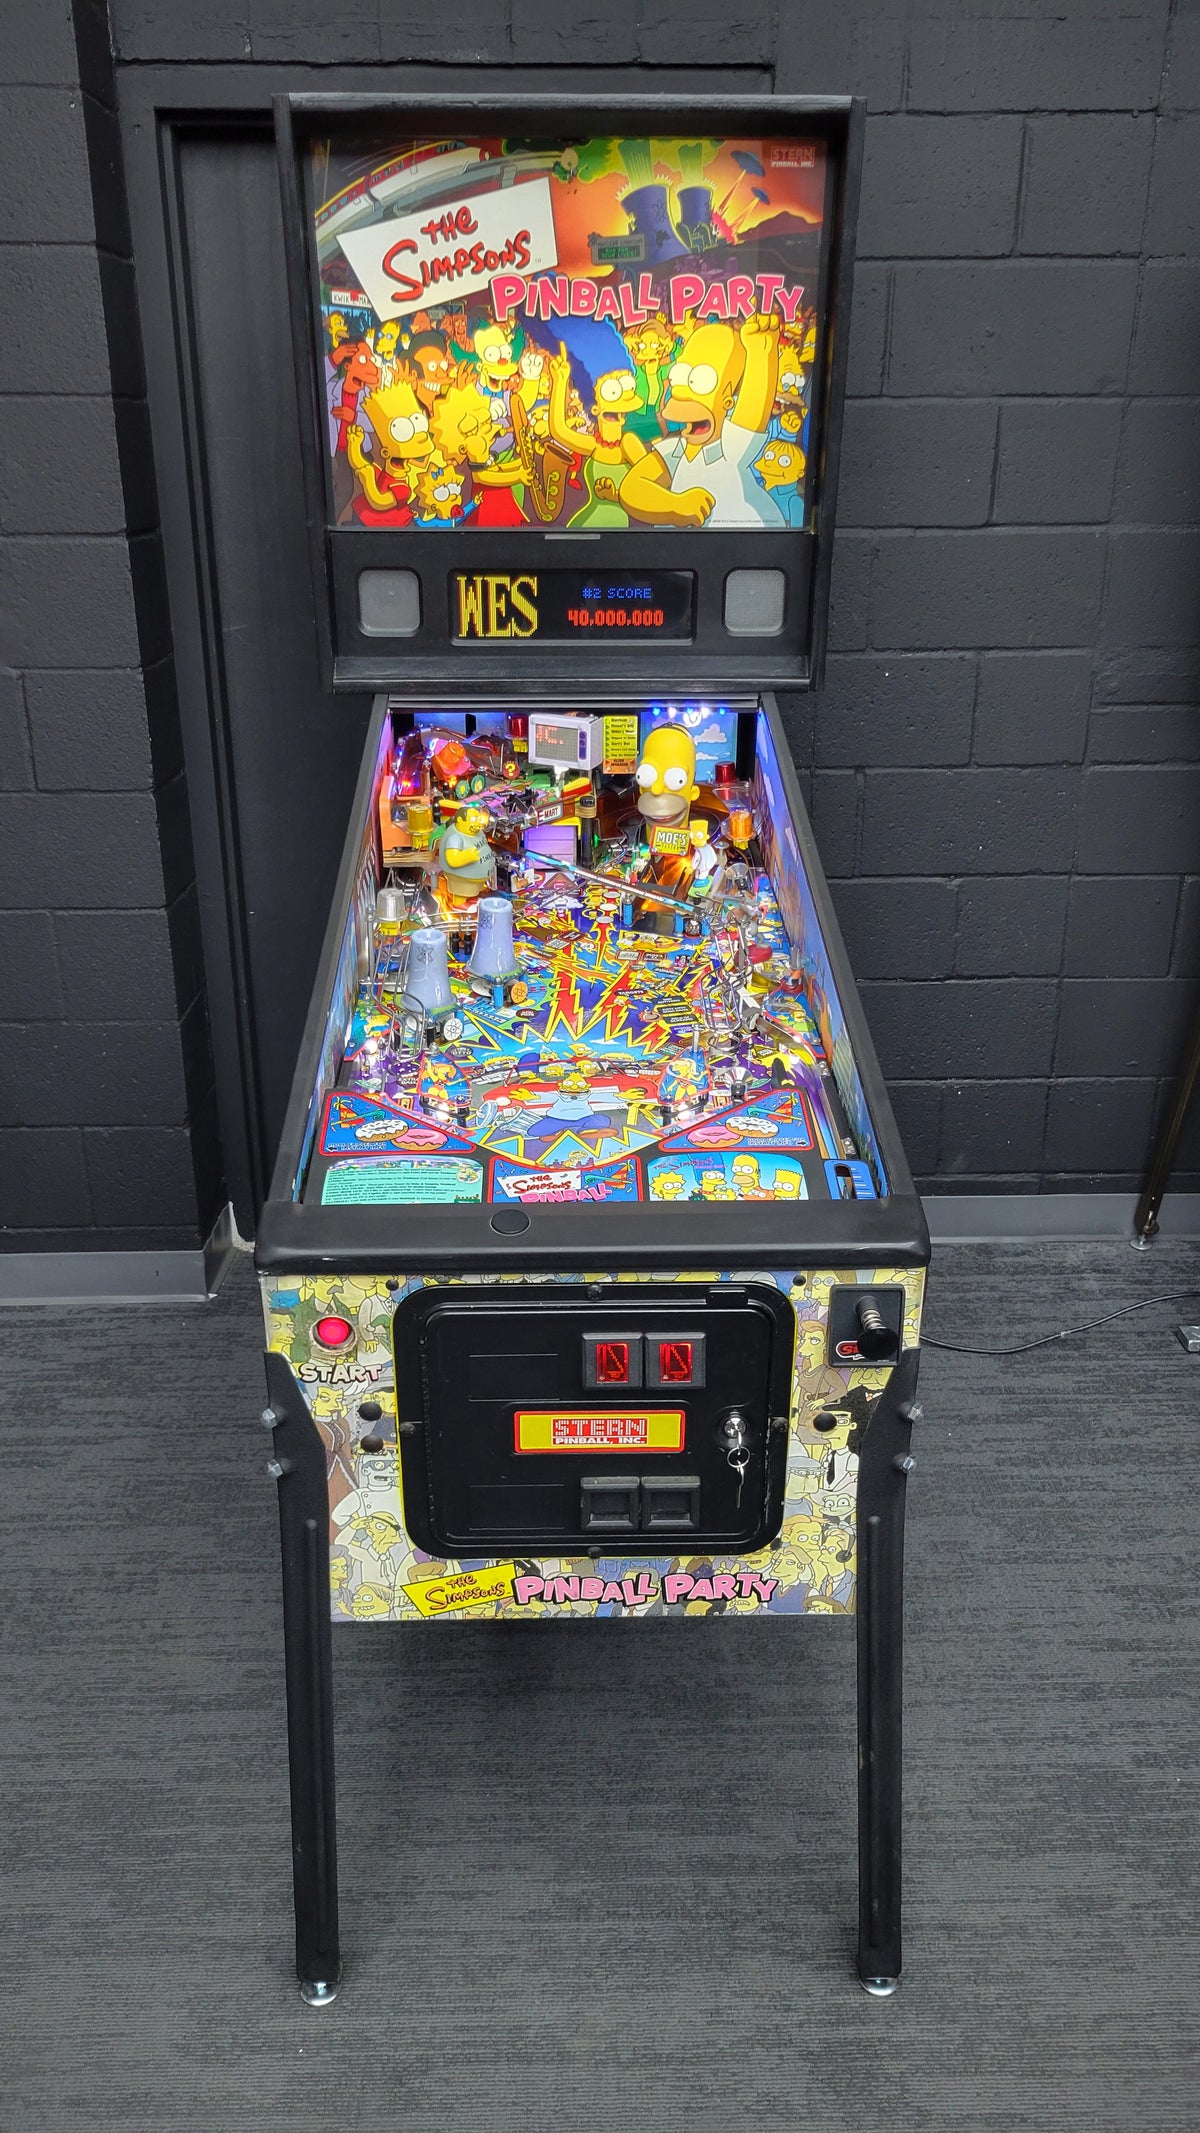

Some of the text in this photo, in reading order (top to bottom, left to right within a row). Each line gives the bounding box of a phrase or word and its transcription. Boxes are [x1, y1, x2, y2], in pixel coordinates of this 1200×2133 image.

[772, 148, 813, 161] STERN
[420, 206, 479, 245] THE
[382, 229, 531, 302] SIMPSONS
[489, 273, 805, 328] PINBALL PARTY
[582, 587, 652, 599] #2 SCORE
[456, 576, 539, 638] WES
[567, 609, 664, 627] 40,000,000
[656, 830, 687, 846] MOE'S
[512, 1180, 572, 1194] SIMPSONS
[299, 1363, 382, 1383] START
[554, 1419, 646, 1436] STERN
[555, 1436, 646, 1445] PINBALL, INC.
[446, 1574, 476, 1589] THE
[513, 1573, 778, 1607] PINBALL PARTY
[425, 1582, 505, 1610] SIMPSONS
